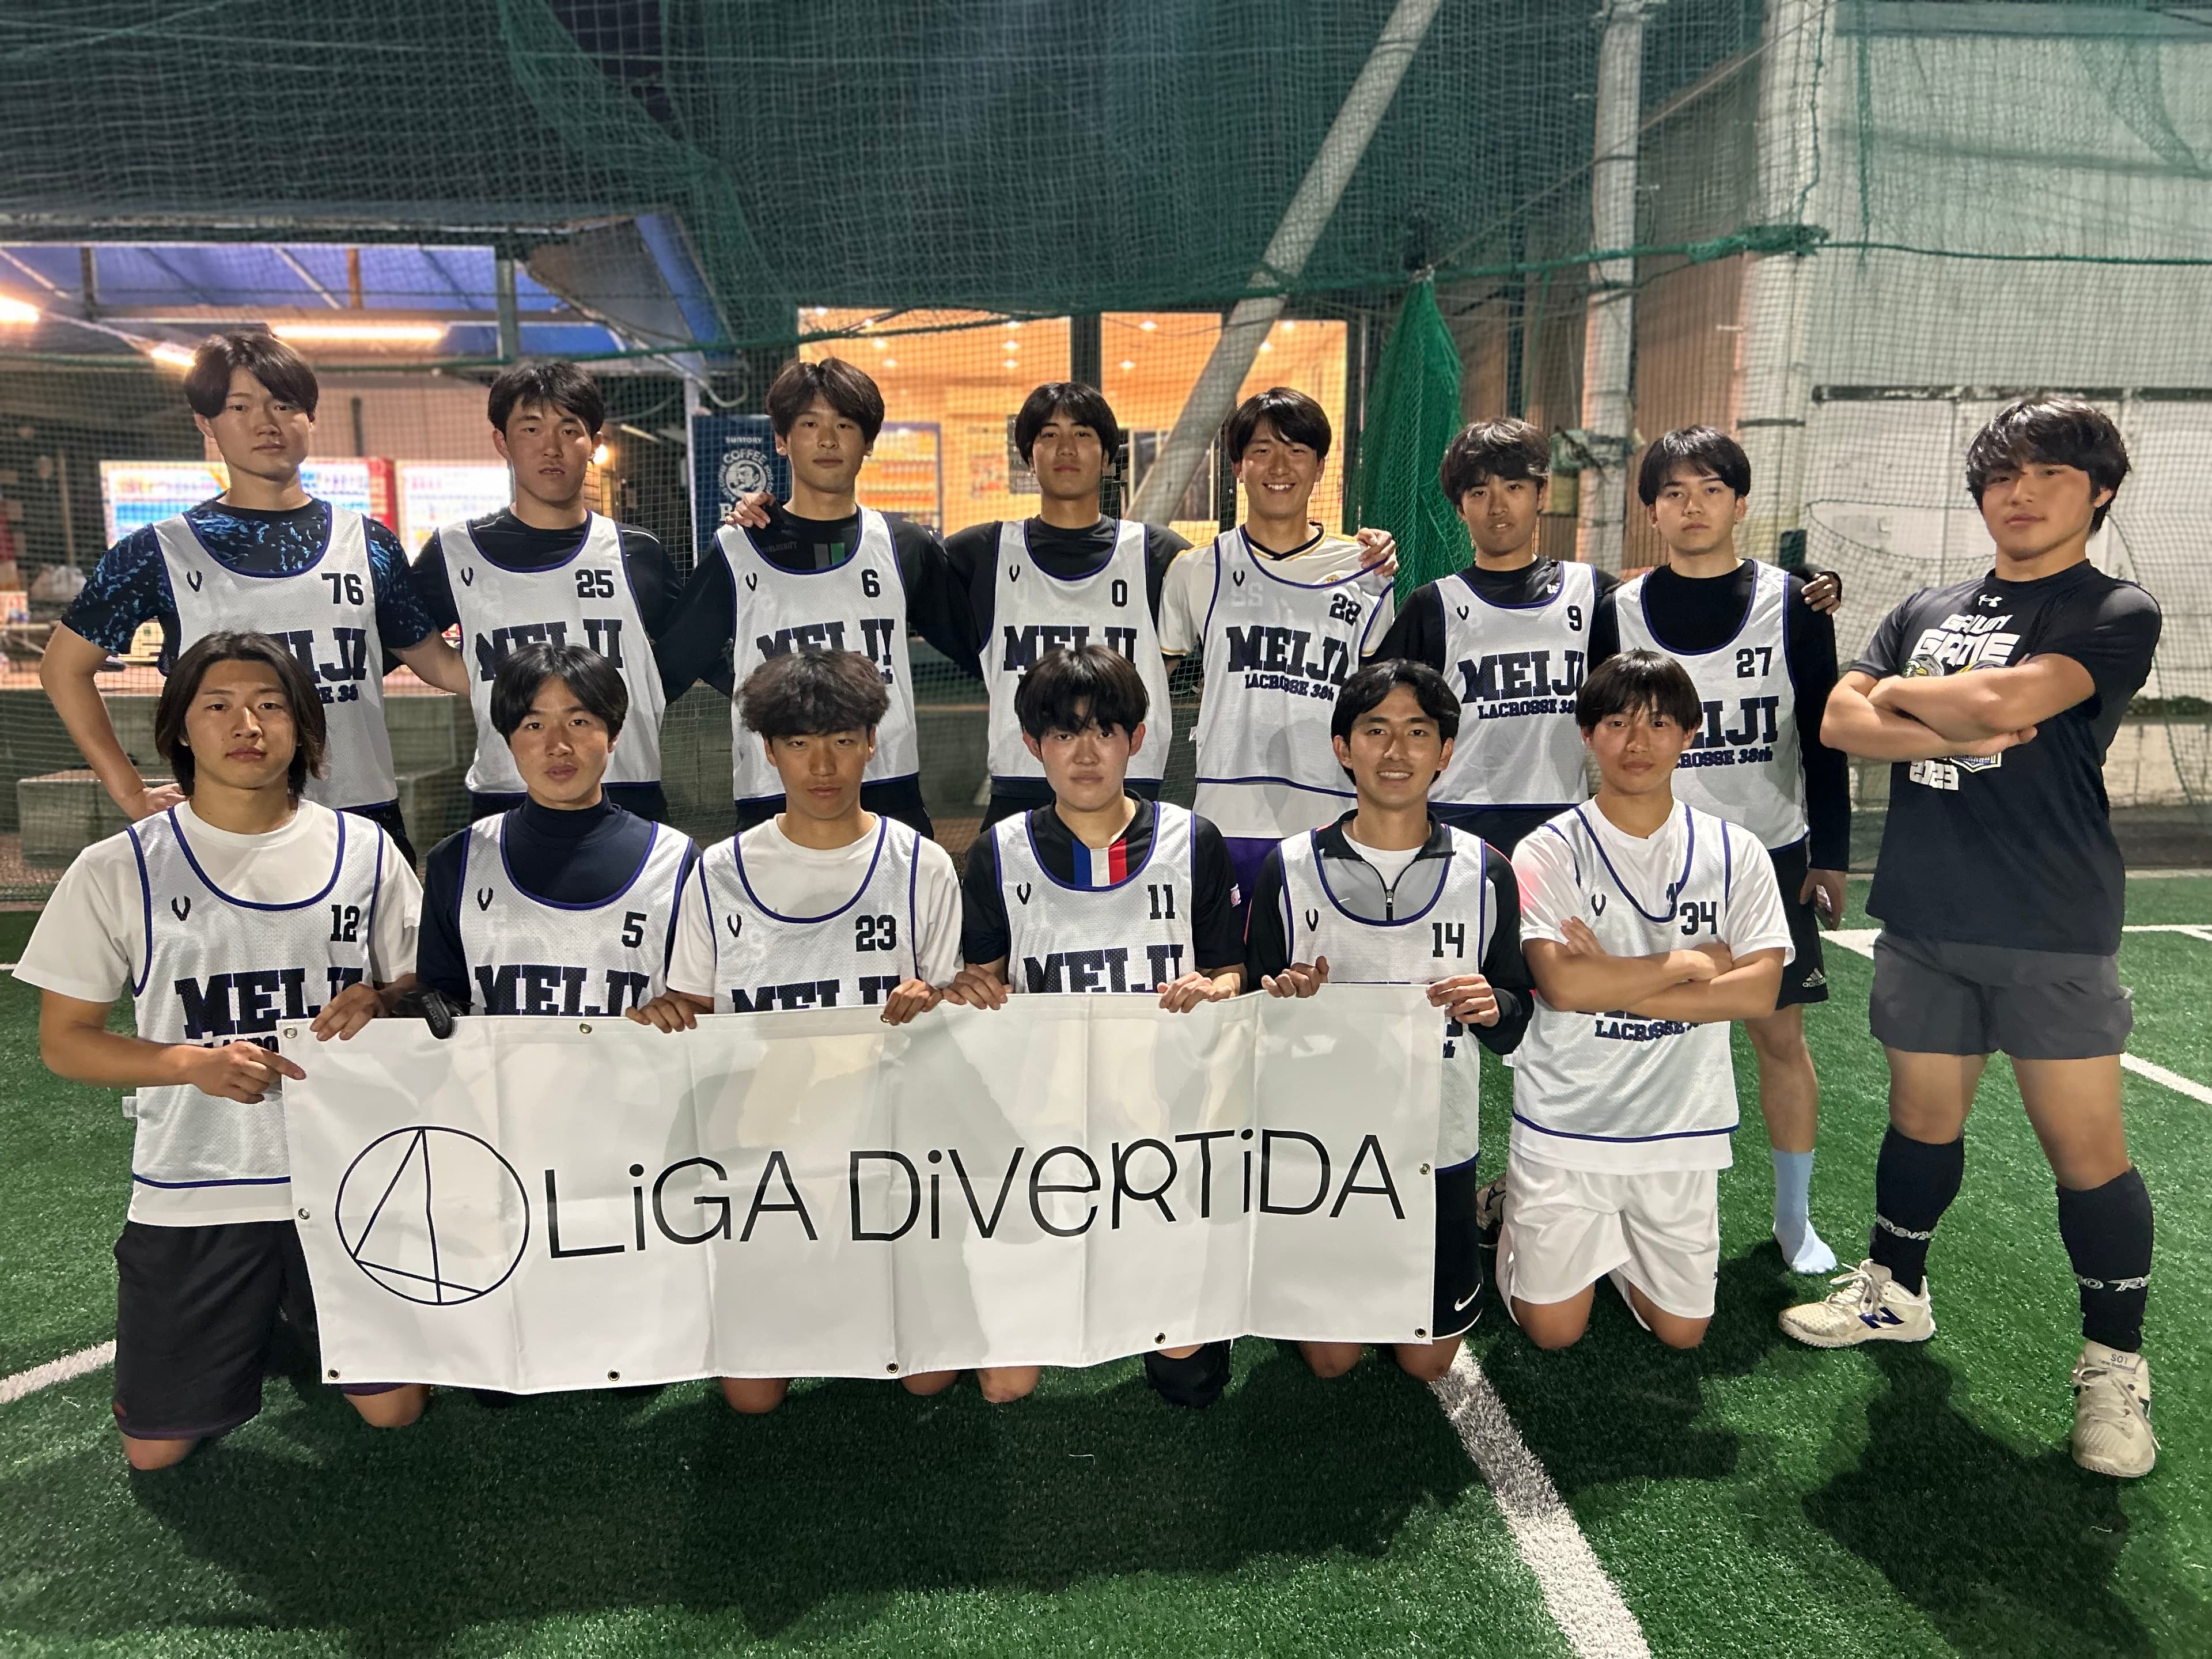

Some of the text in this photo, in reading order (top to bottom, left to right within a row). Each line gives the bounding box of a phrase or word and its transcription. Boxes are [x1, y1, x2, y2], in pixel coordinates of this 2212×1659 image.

[723, 449, 767, 464] COFFEE
[321, 573, 364, 605] 76
[575, 569, 615, 598] 25
[861, 569, 880, 597] 6
[1112, 579, 1127, 607] 0
[1329, 593, 1361, 626] 22
[1567, 605, 1582, 631] 9
[1226, 625, 1347, 687] MEIJI
[1736, 647, 1772, 678] 27
[1910, 628, 2021, 667] GAME
[1478, 699, 1575, 720] LACROSSE 38
[1690, 696, 1779, 749] IJI
[1738, 746, 1773, 764] 38th
[1147, 884, 1176, 919] 11
[1679, 901, 1717, 935] 34
[330, 904, 360, 942] 12
[622, 911, 647, 948] 5
[855, 915, 896, 952] 23
[1432, 923, 1465, 958] 14
